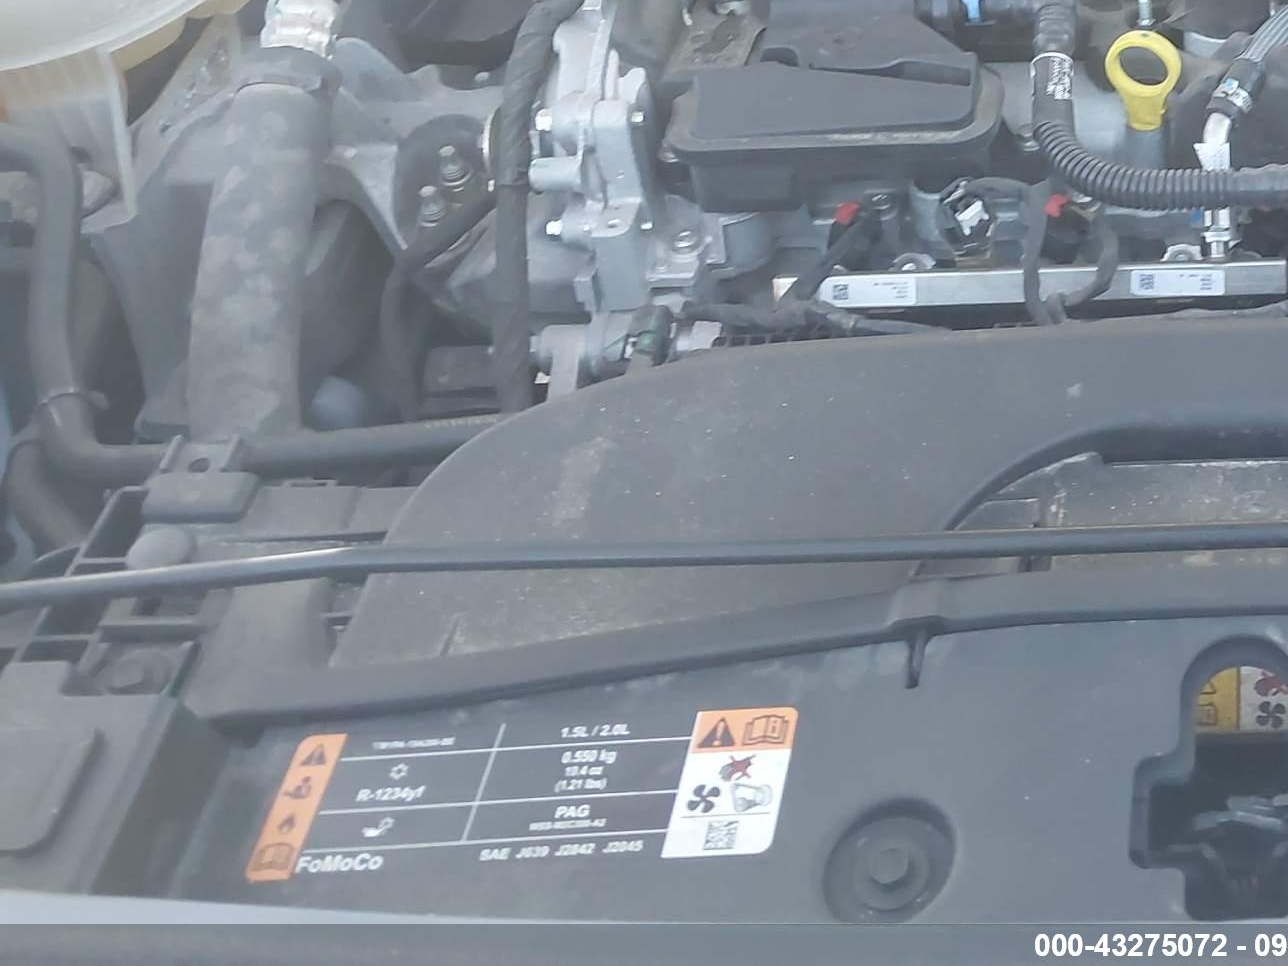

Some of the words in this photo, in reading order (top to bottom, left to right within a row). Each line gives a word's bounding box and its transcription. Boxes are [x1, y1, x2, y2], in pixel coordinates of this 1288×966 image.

[600, 723, 630, 736] 2.0L
[599, 749, 617, 764] kg
[355, 786, 426, 802] R-1234yf
[554, 804, 591, 819] PAG
[479, 847, 512, 861] SAE
[295, 852, 384, 873] FoMoCo
